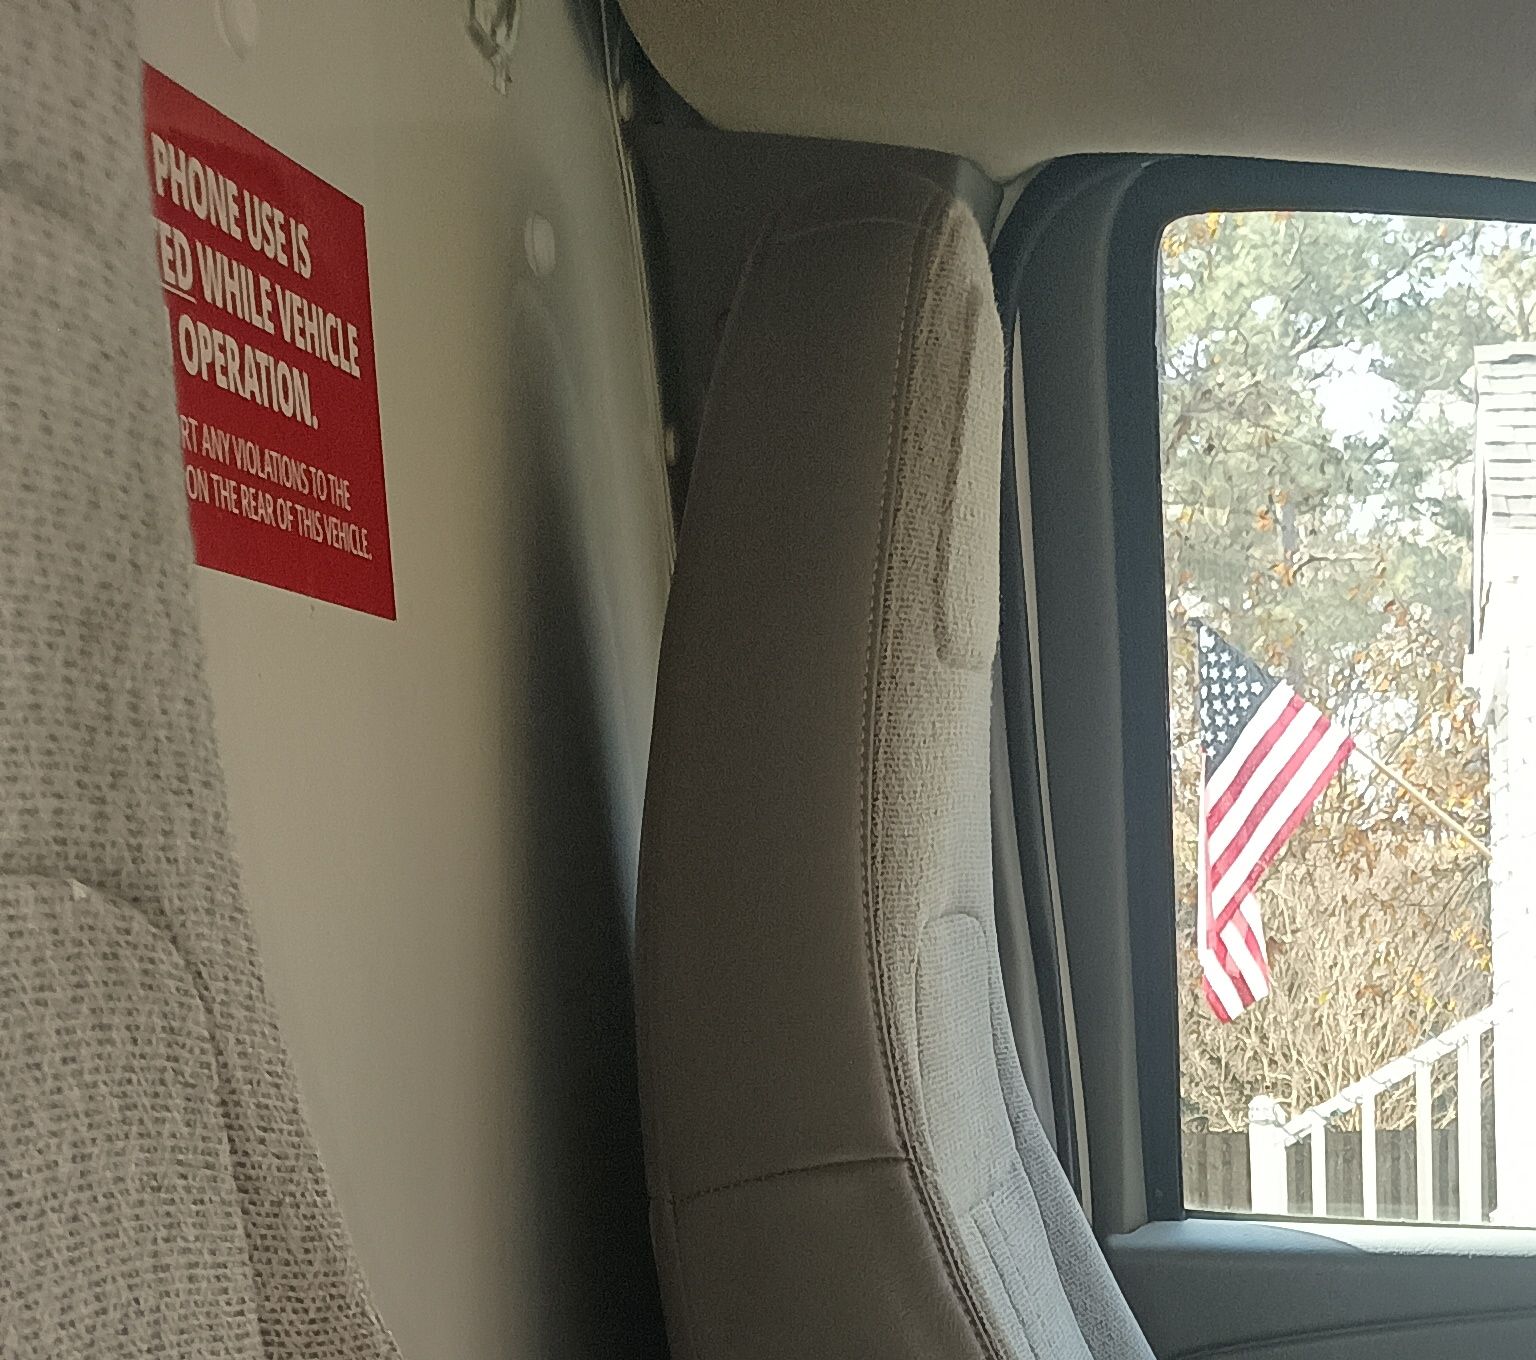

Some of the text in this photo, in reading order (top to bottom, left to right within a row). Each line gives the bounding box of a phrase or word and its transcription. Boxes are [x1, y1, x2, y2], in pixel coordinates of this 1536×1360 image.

[150, 132, 312, 280] PHONE USE IS
[156, 219, 360, 378] ED WHILE VEHICLE
[178, 313, 319, 430] OPERATION.
[186, 464, 372, 560] ON THE REAR OF THIS VEHICLE.
[202, 423, 231, 466] ANY
[232, 435, 309, 496] VIOLATIONS
[310, 466, 327, 503] TO
[328, 472, 351, 511] THE
